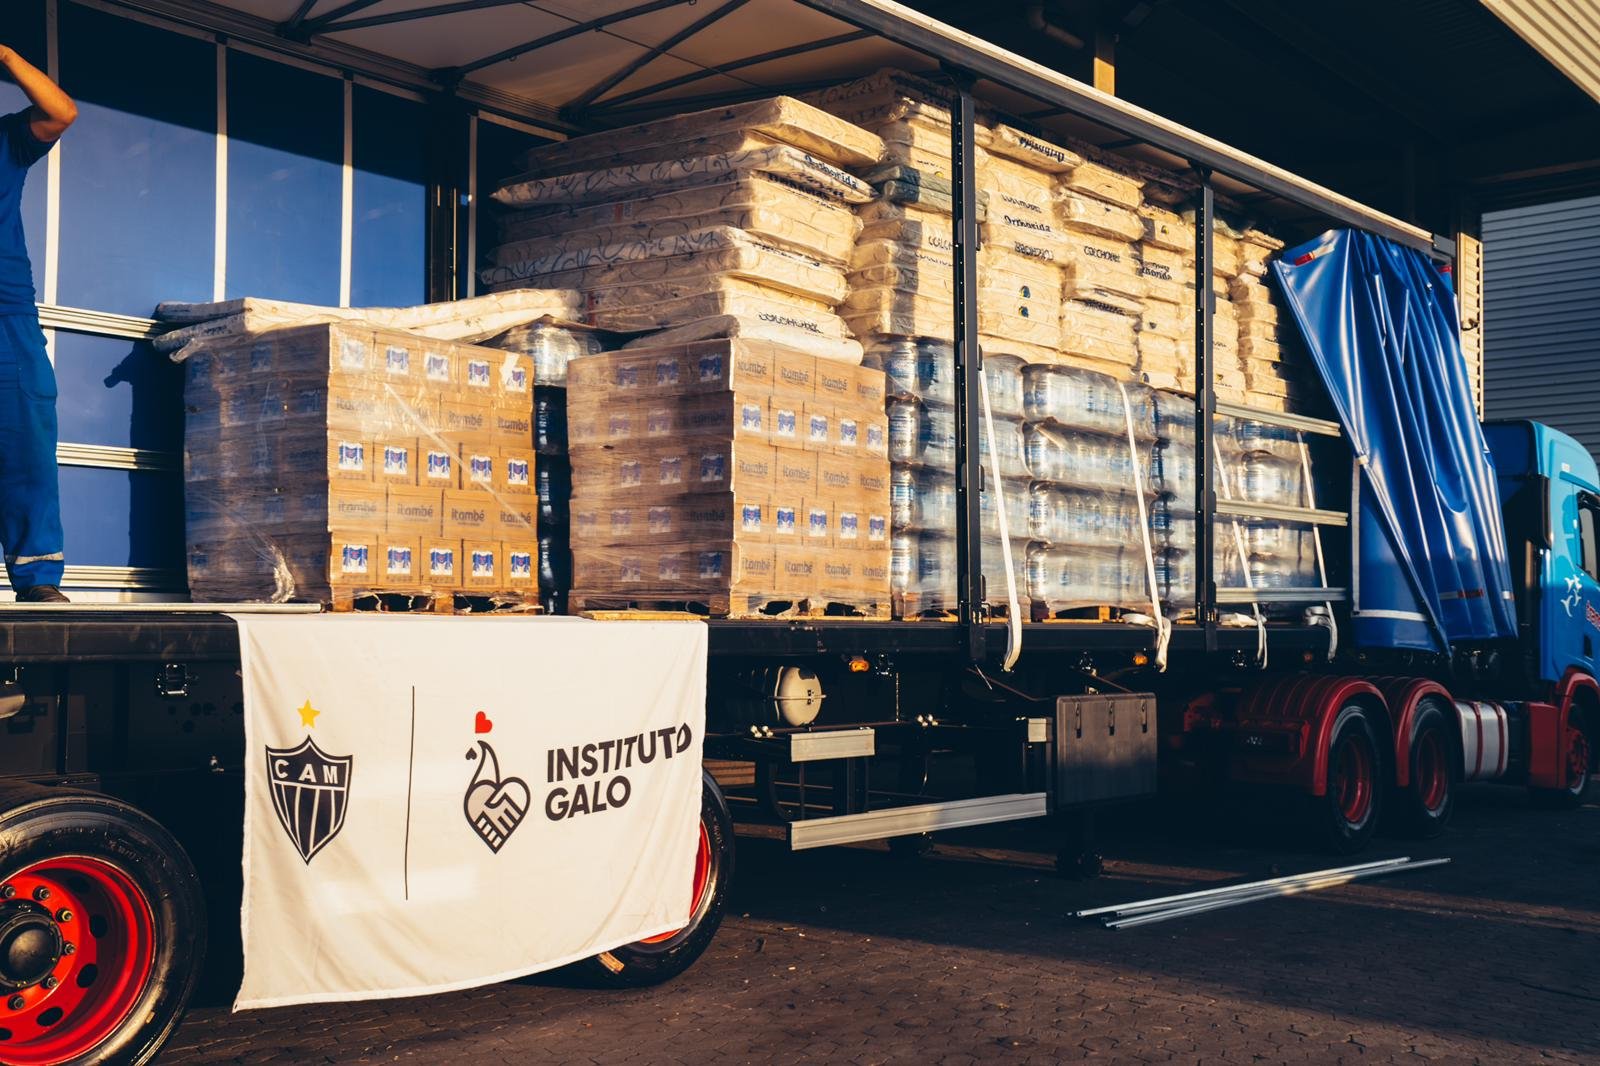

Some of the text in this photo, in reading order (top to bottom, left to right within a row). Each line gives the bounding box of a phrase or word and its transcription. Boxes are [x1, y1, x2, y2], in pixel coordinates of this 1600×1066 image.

[451, 508, 485, 522] itambé
[547, 722, 692, 783] INSTITUTO
[545, 775, 632, 822] GALO
